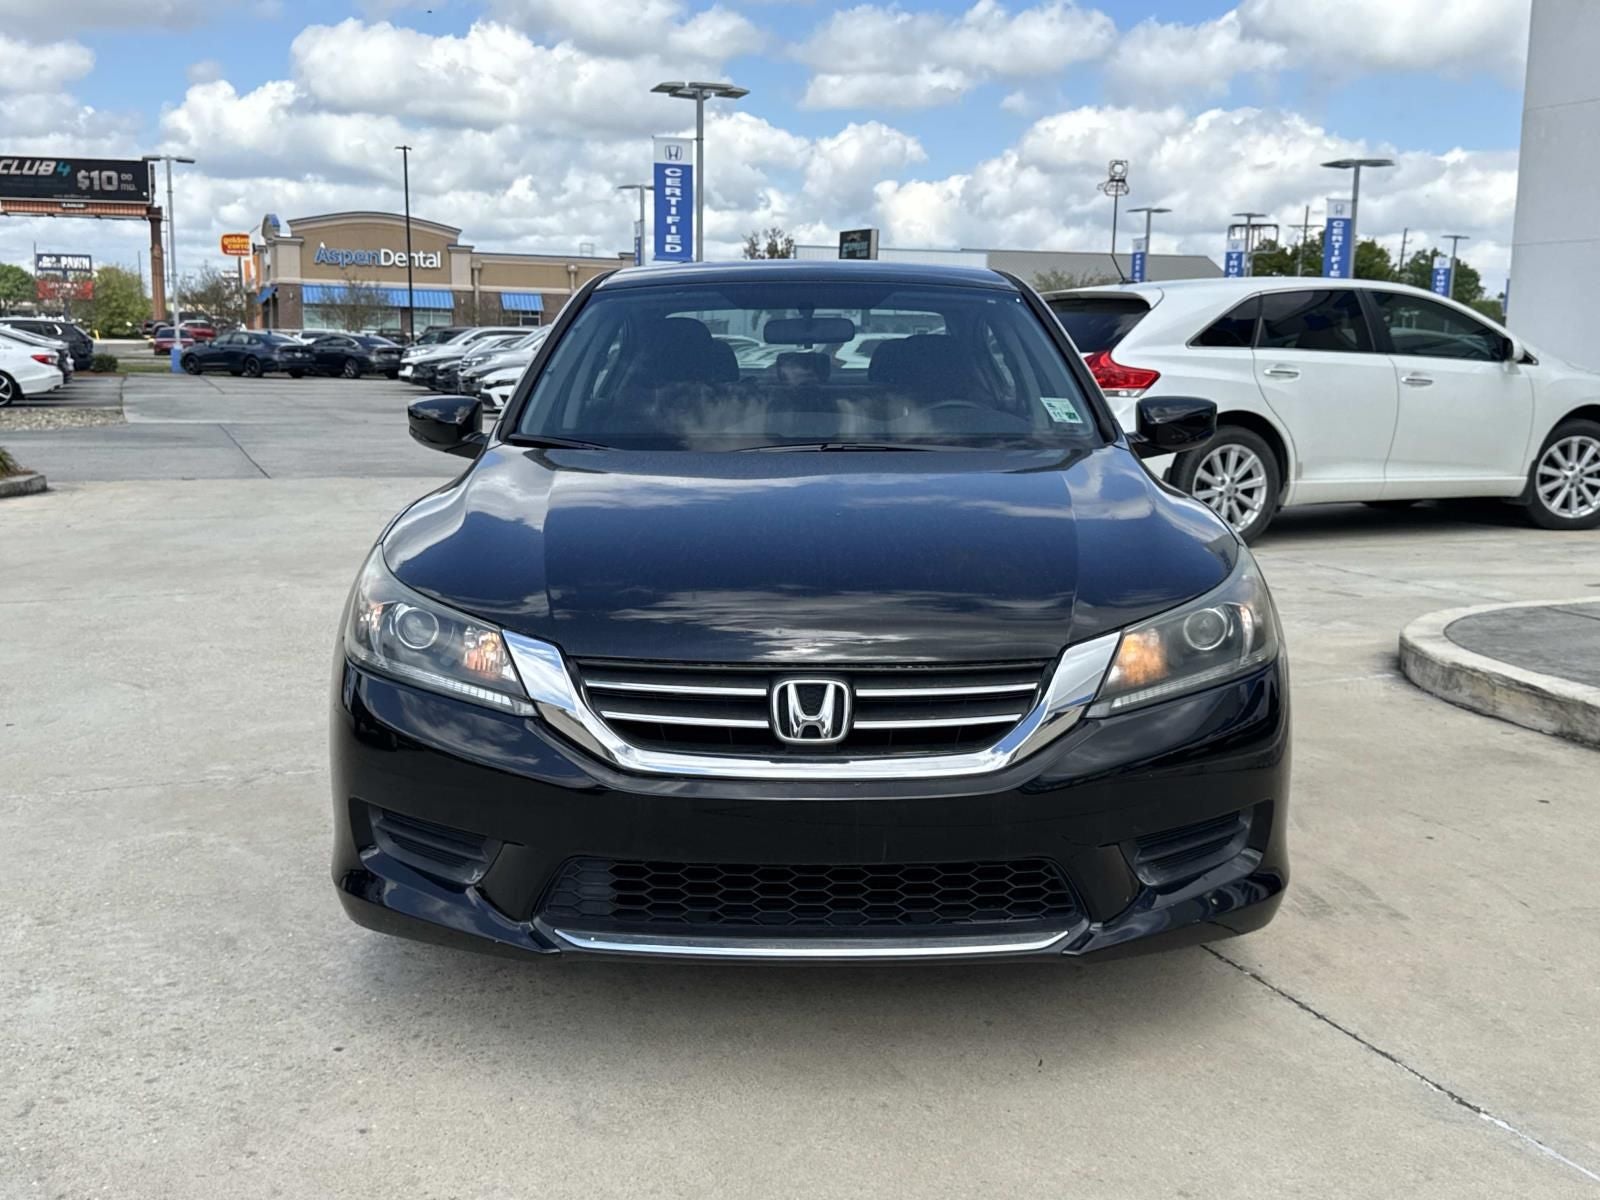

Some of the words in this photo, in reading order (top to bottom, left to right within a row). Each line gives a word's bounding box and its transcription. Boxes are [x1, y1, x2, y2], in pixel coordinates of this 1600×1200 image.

[77, 169, 118, 191] $10
[664, 168, 682, 253] CERTIFIED
[61, 256, 90, 270] PAWN
[1329, 220, 1344, 277] CERTIFIE
